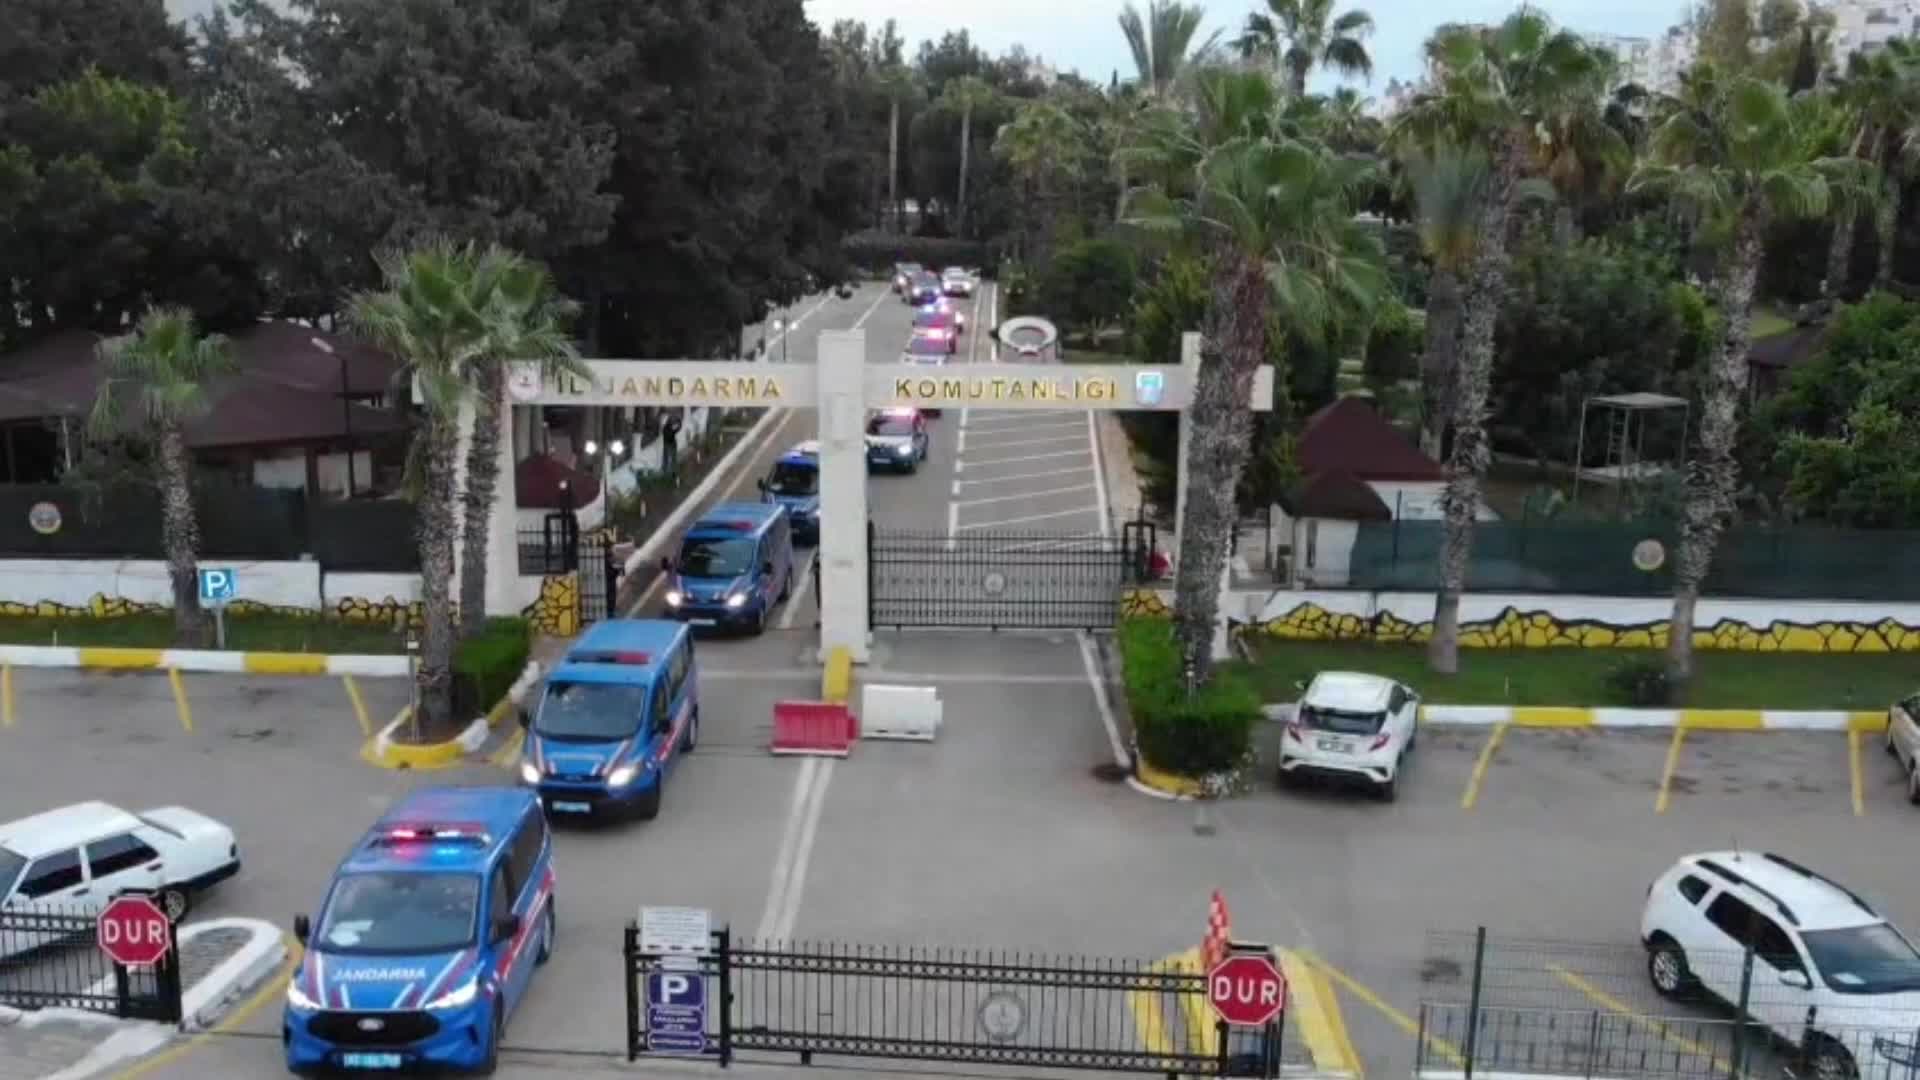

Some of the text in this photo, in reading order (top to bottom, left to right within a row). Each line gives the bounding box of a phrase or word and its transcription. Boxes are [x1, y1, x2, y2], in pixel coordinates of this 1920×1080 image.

[600, 375, 781, 399] JANDARMA
[206, 570, 226, 597] P
[103, 919, 164, 945] DUR
[331, 966, 427, 983] JANDARMA
[661, 975, 688, 1003] P
[1214, 975, 1277, 1005] DUR
